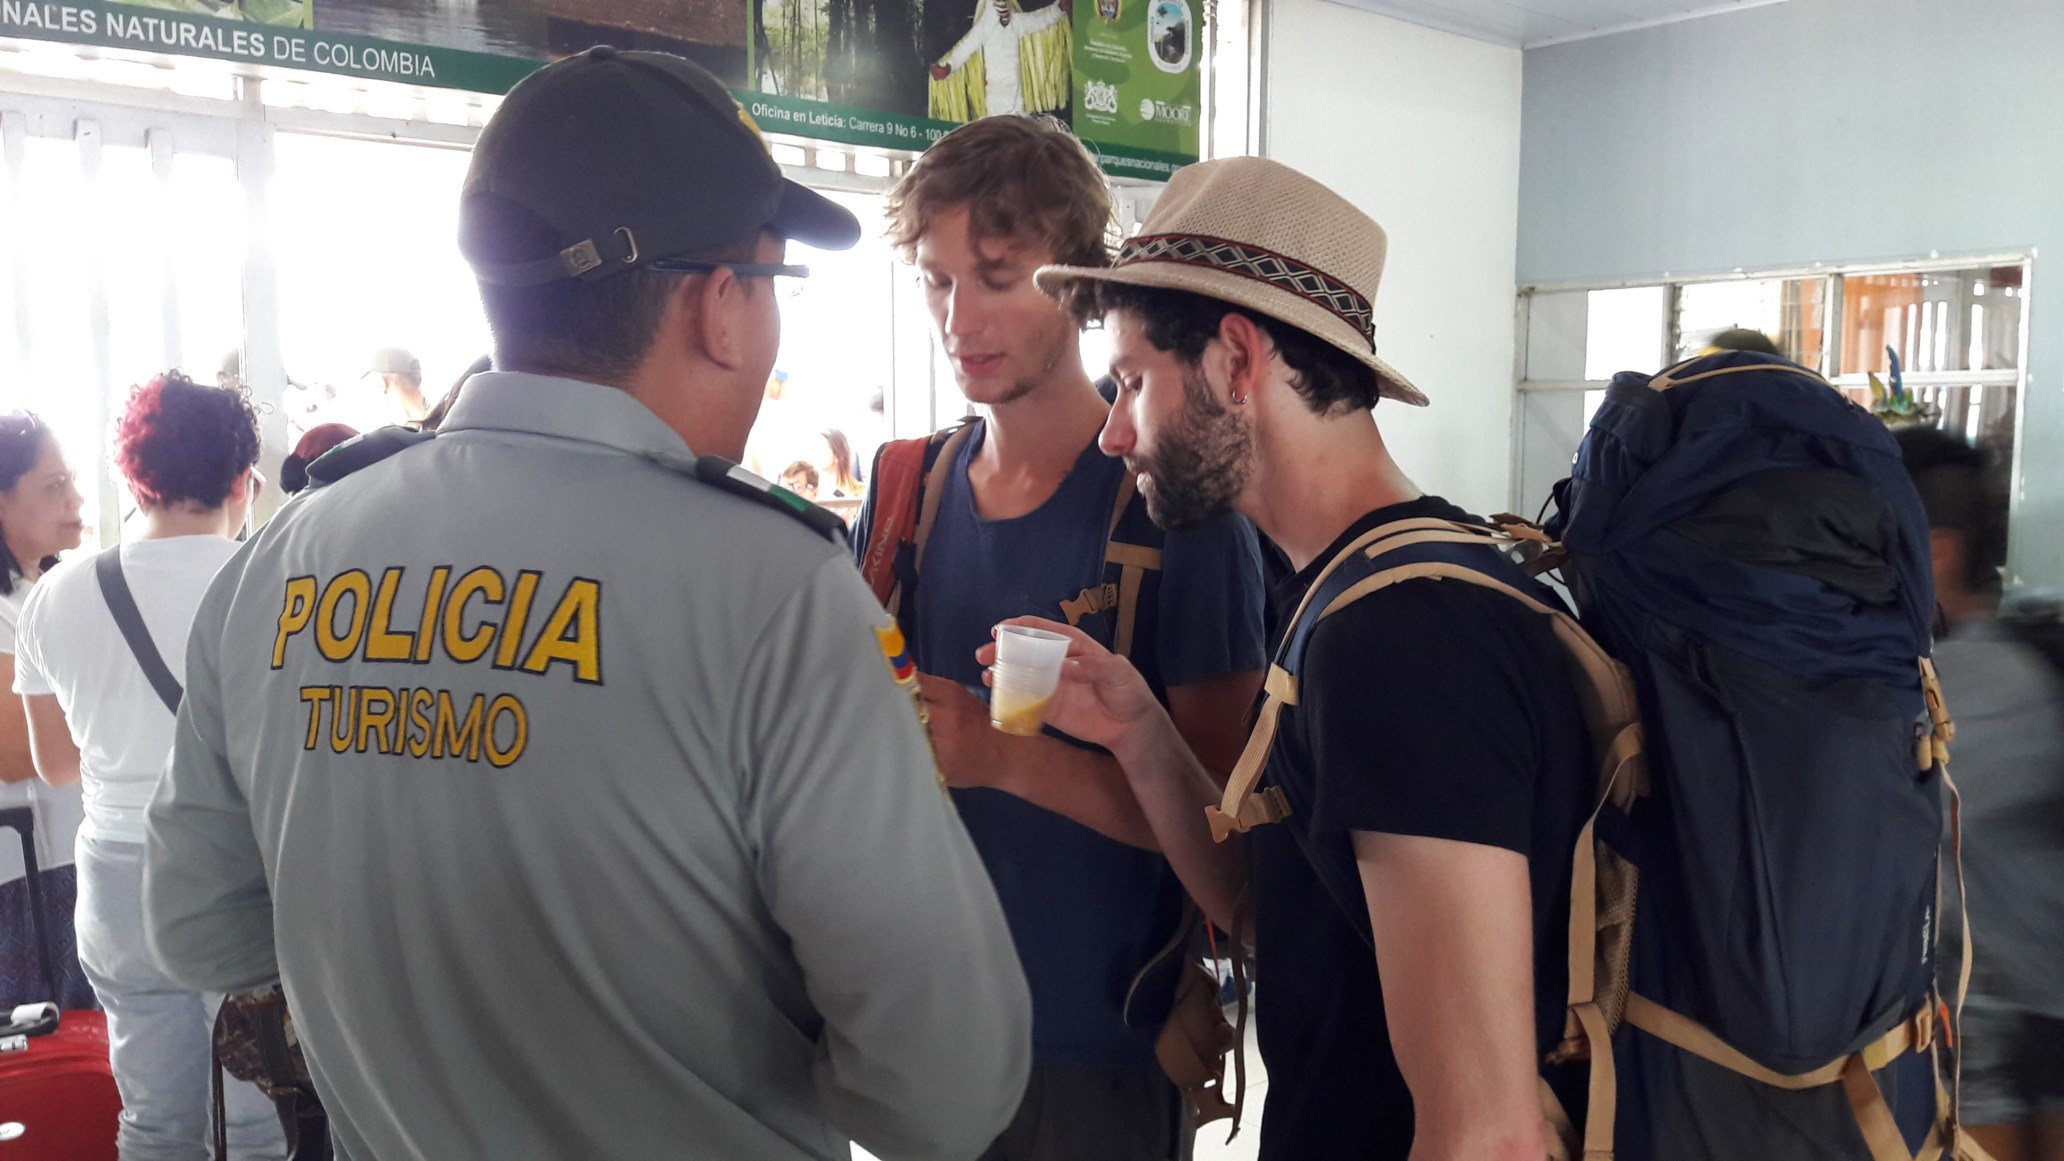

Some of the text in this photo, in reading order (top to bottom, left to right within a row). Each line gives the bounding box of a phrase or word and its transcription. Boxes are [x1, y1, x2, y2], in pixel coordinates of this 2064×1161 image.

[105, 12, 266, 58] NATURALES
[273, 36, 307, 63] DE
[313, 41, 436, 78] COLOMBIA
[751, 102, 791, 121] Oficina
[793, 112, 807, 123] en
[808, 110, 846, 129] Leticia:
[849, 116, 885, 134] Carrera
[886, 122, 893, 135] 9
[895, 123, 909, 138] No
[910, 126, 917, 139] 6
[270, 564, 605, 687] POLICIA
[299, 684, 529, 769] TURISMO
